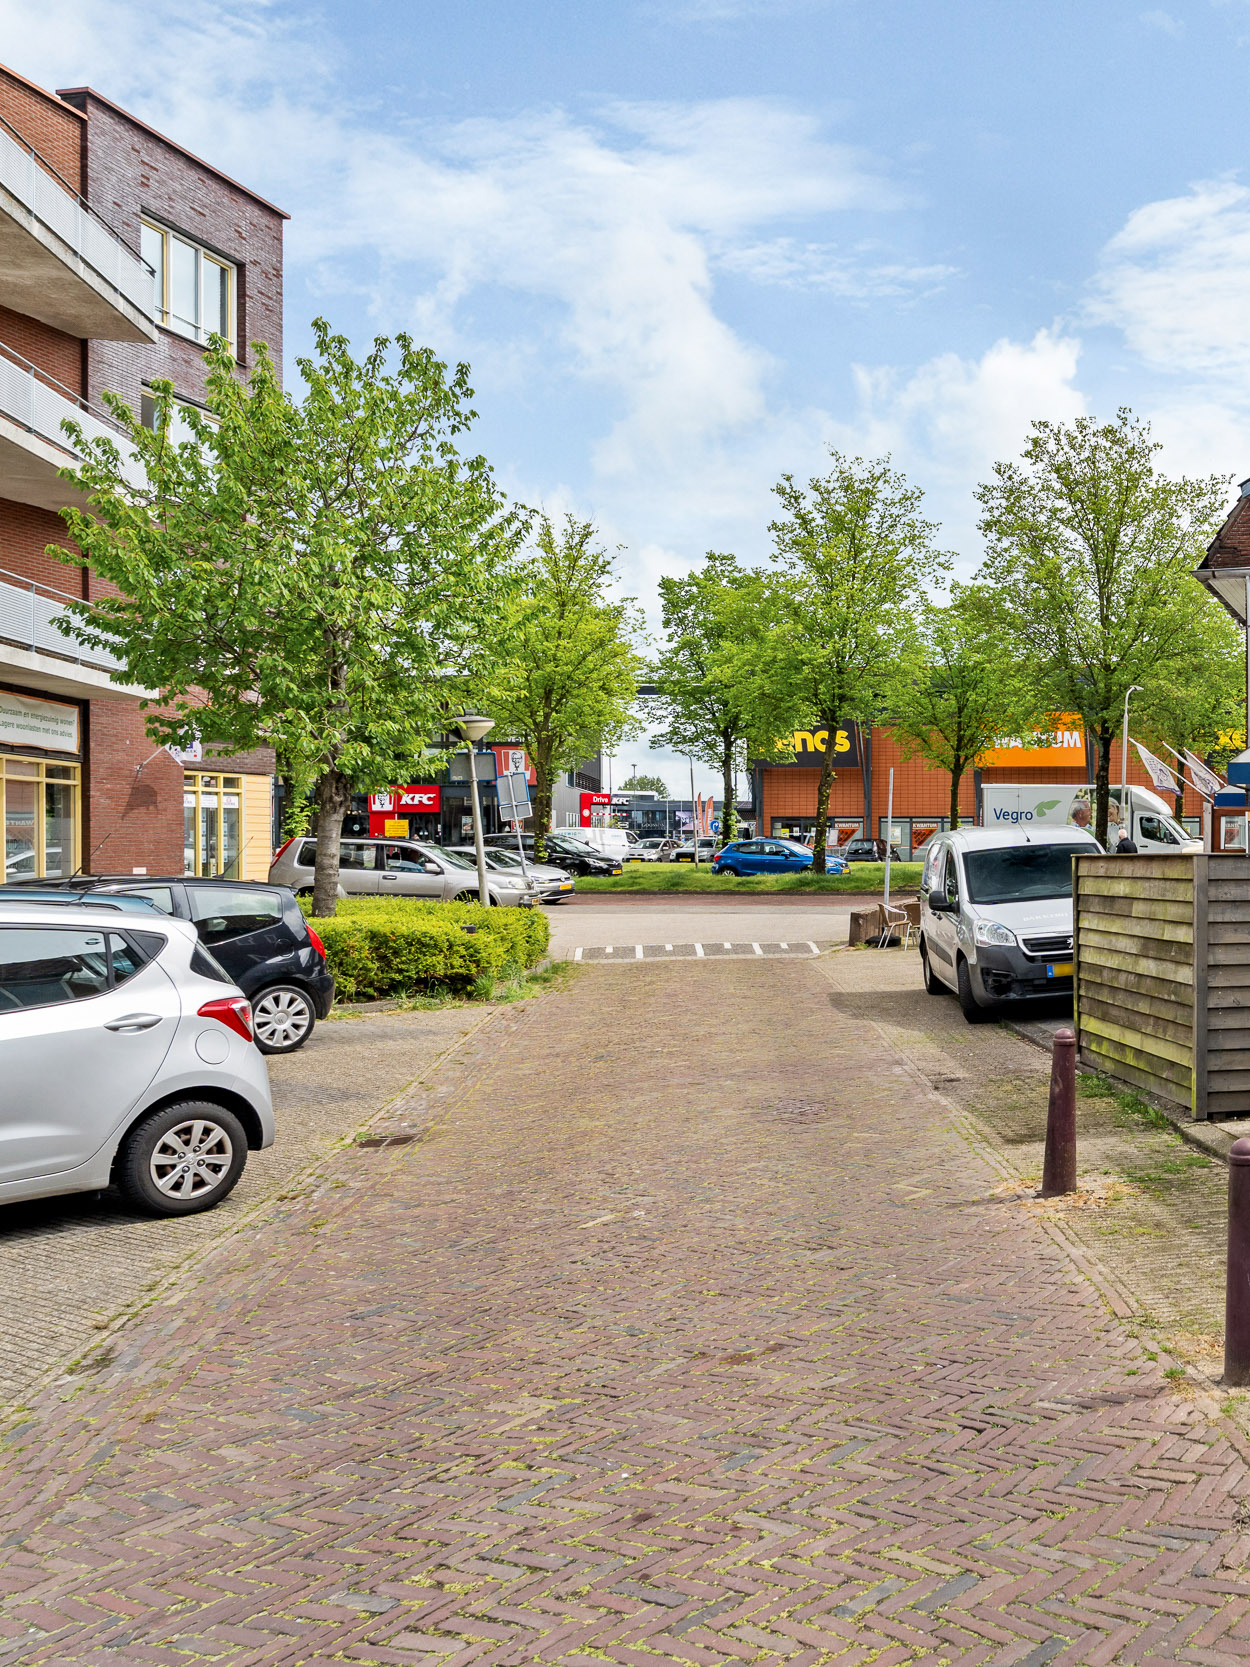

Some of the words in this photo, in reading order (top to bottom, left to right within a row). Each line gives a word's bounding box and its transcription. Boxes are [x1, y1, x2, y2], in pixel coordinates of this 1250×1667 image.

[42, 727, 50, 735] met
[400, 793, 436, 805] KFC
[611, 797, 630, 805] KFC
[993, 807, 1034, 824] Vegro
